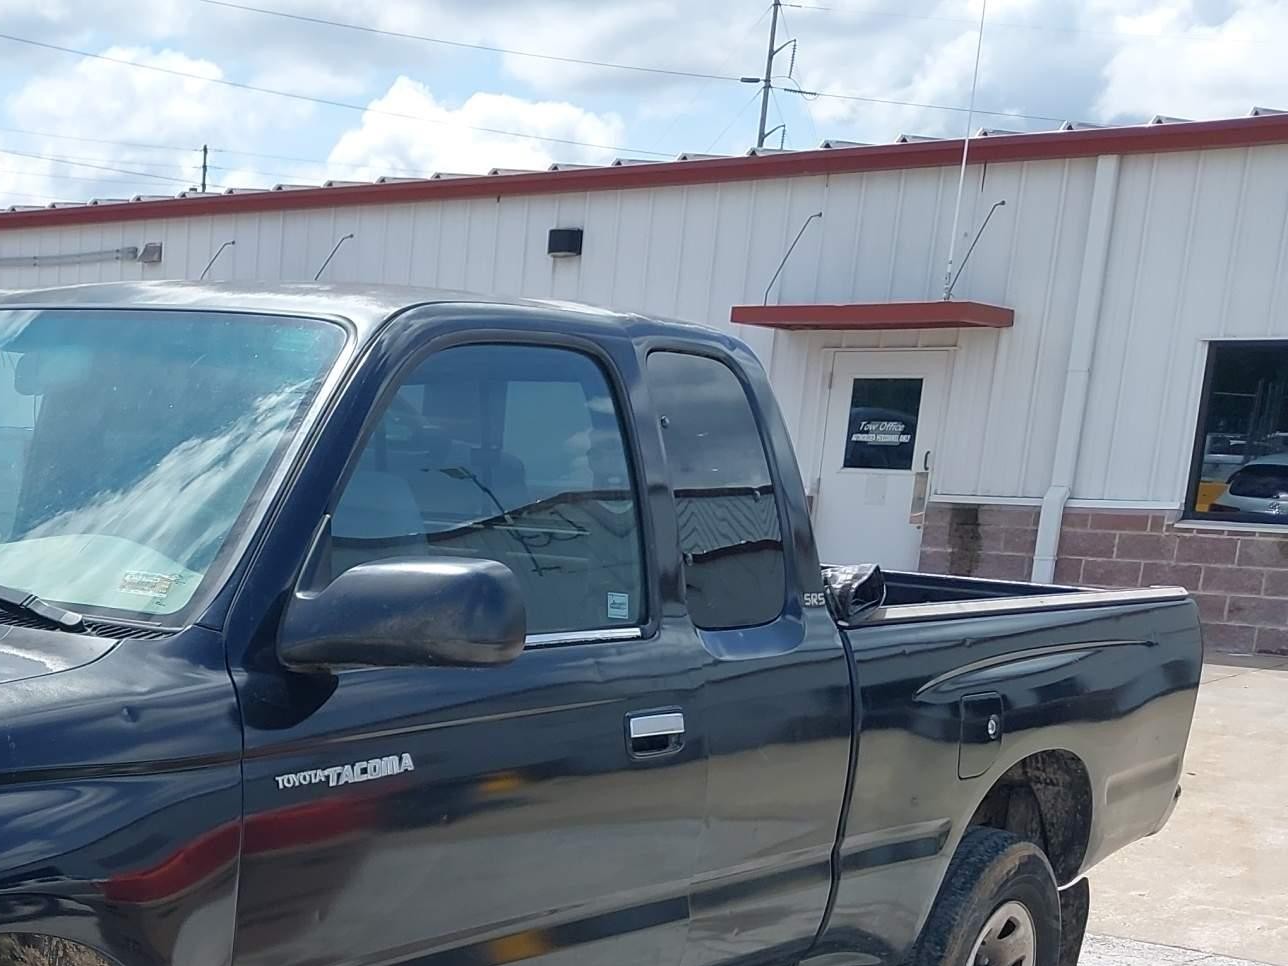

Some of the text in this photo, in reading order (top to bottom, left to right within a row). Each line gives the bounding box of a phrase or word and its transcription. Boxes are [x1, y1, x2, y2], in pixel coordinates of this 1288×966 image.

[859, 421, 905, 431] Tow Office
[276, 753, 414, 789] TOYOTA TACOMA
